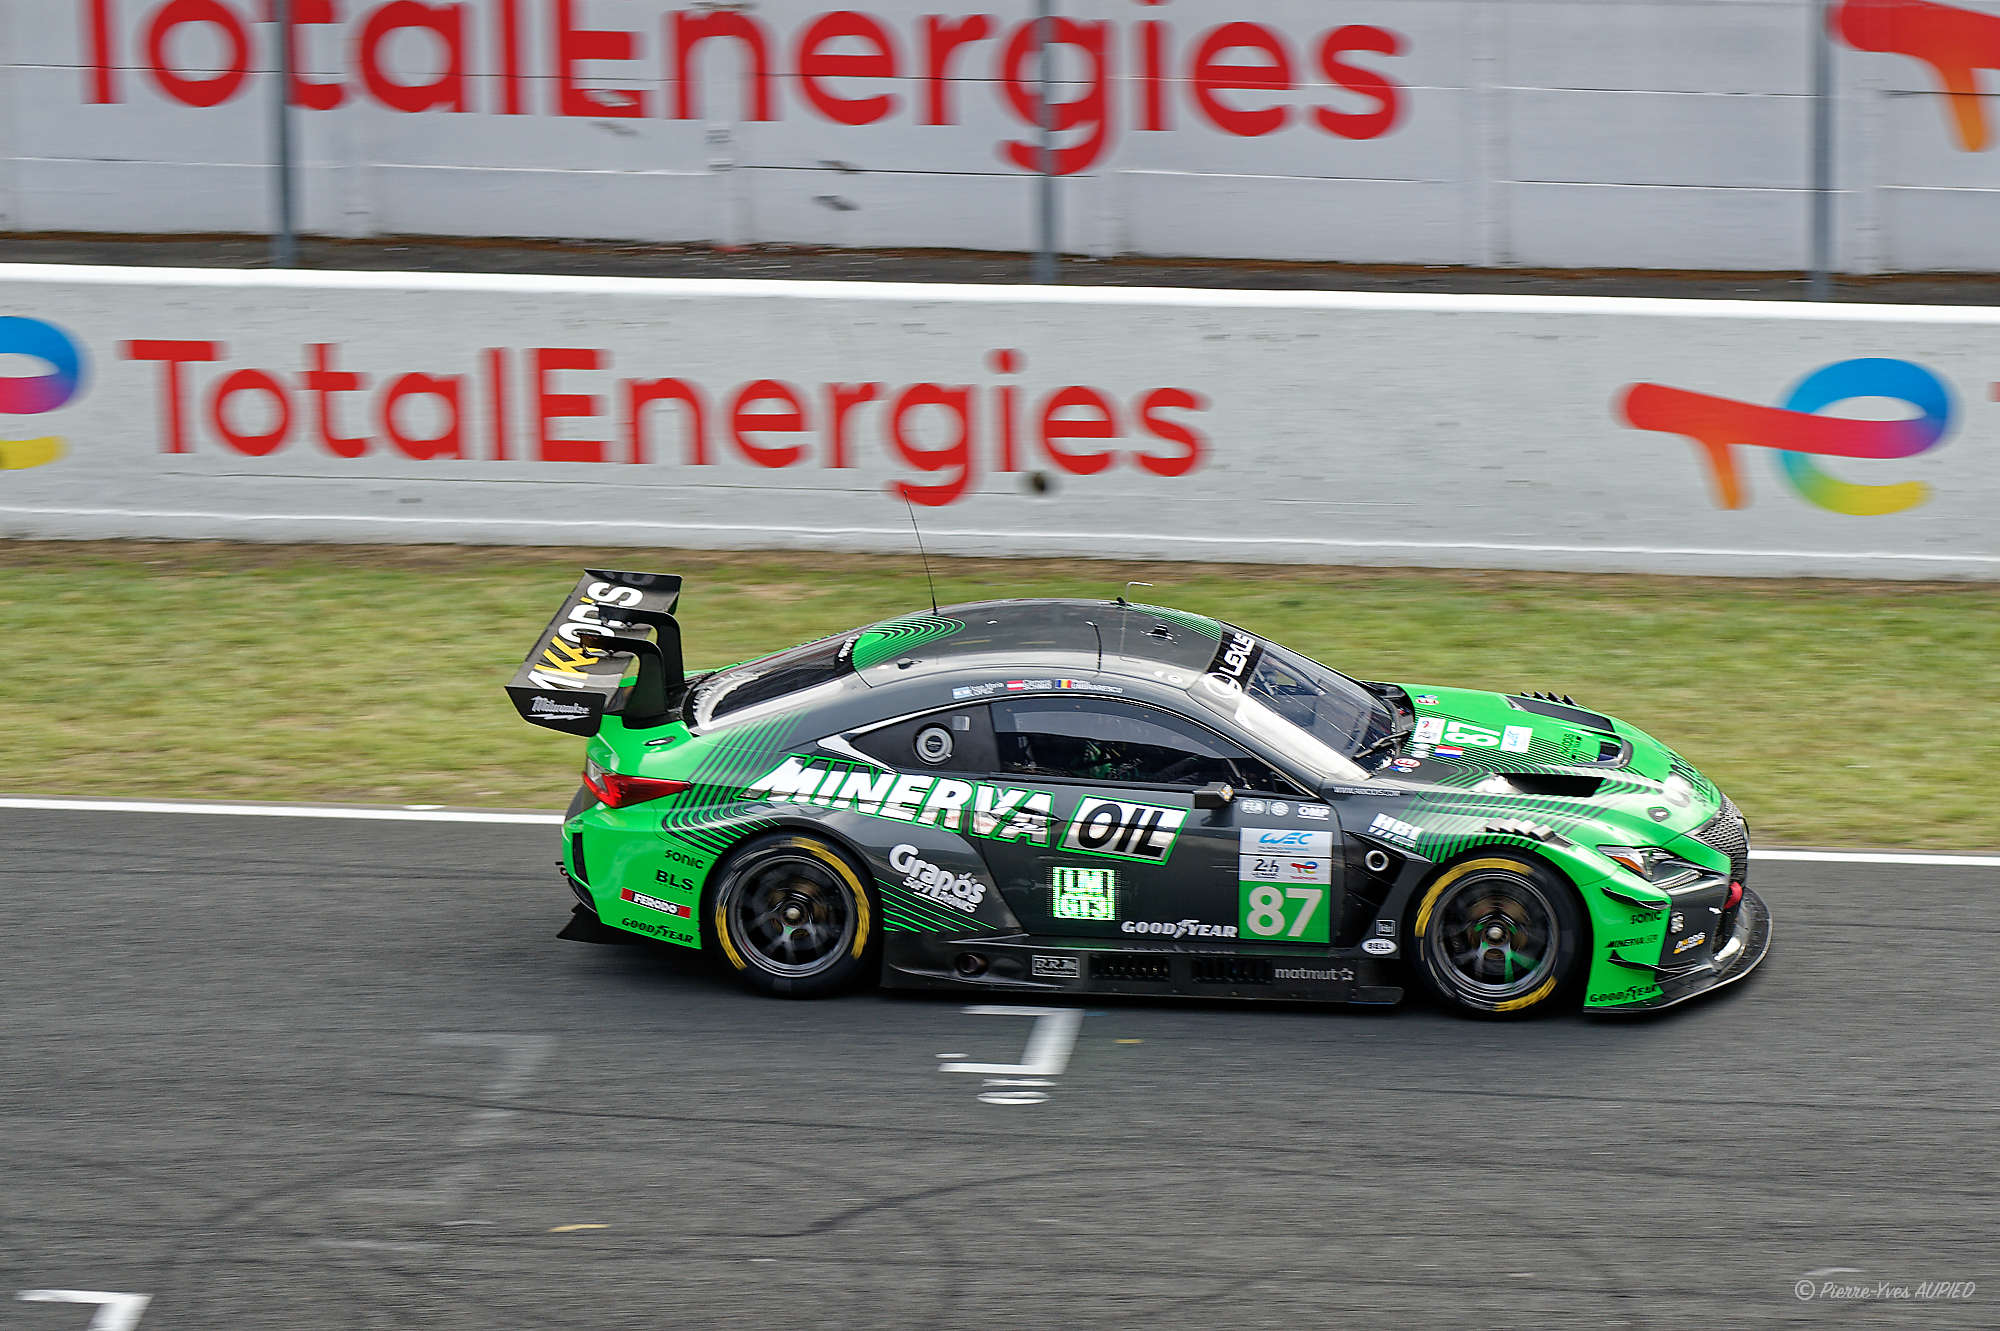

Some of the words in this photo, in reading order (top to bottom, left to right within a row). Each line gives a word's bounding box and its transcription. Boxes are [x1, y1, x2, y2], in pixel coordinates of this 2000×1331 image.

[118, 338, 1208, 506] TotalEnergies
[738, 755, 1052, 846] MINERVA
[1076, 802, 1166, 858] OIL
[1298, 806, 1330, 817] OMP
[1259, 832, 1313, 845] WEC
[656, 869, 694, 891] BLS
[633, 892, 680, 914] FERODO
[1246, 885, 1323, 937] 87
[621, 917, 694, 943] GOODYEAR
[1120, 919, 1238, 939] GOODYEAR
[1274, 966, 1337, 981] matmut
[1589, 984, 1659, 1003] GOODYEAR
